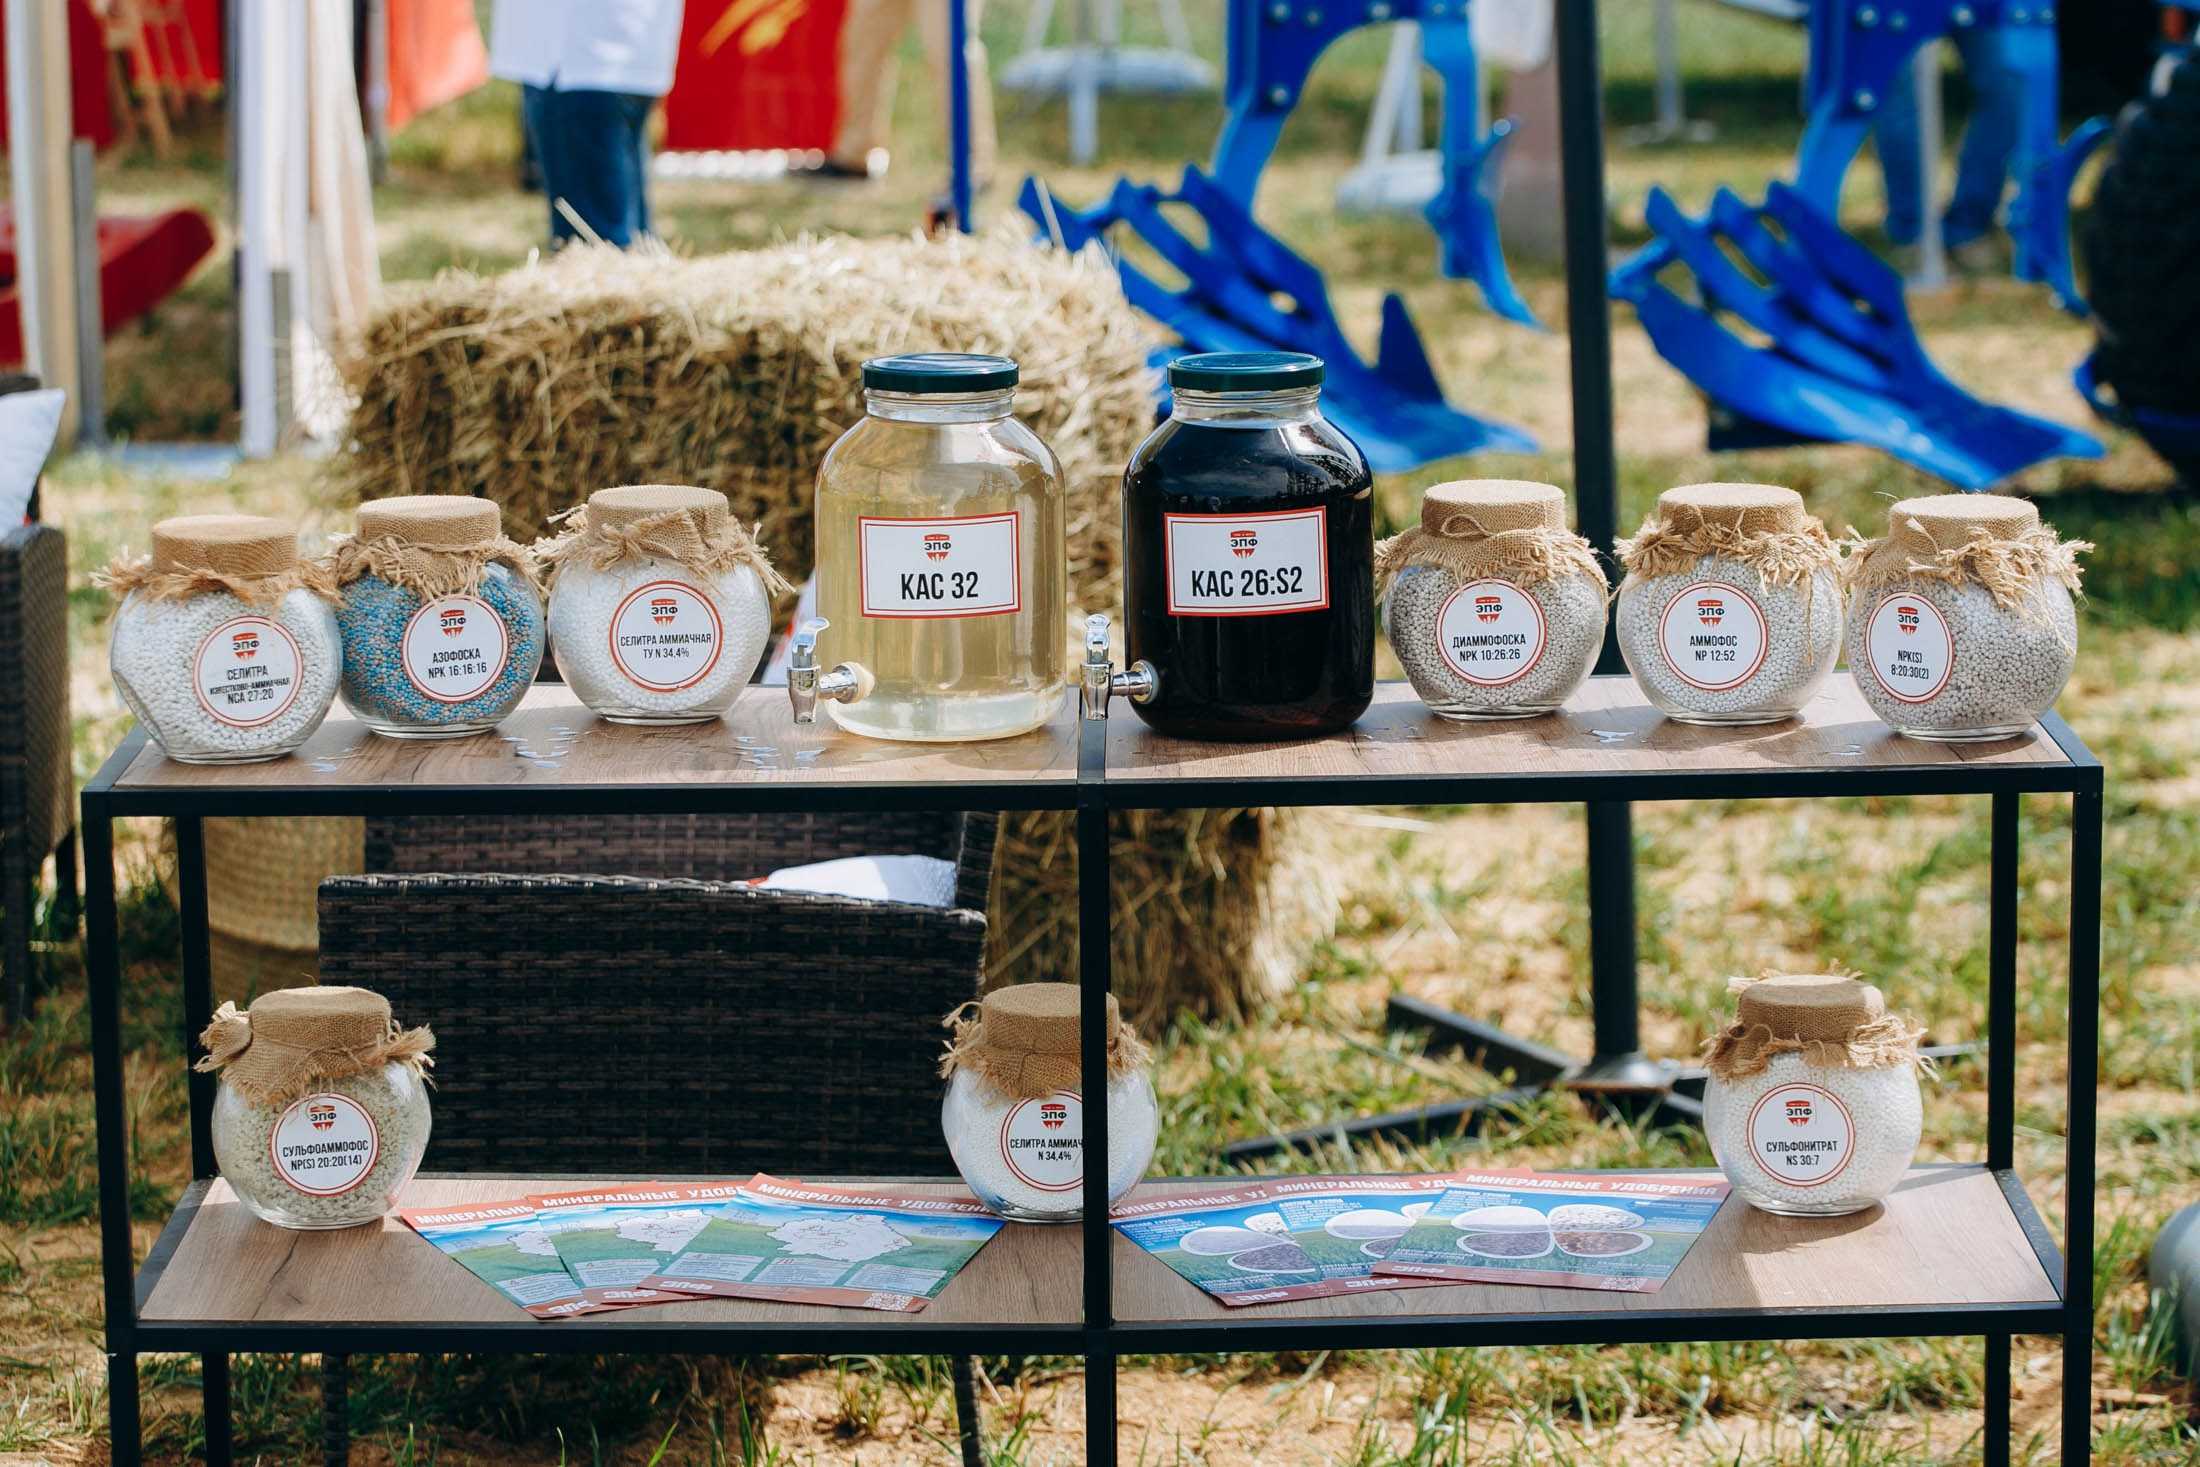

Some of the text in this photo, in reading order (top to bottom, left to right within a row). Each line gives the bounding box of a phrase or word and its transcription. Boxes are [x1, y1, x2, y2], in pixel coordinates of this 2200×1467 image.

[924, 541, 952, 551] ЭПФ
[1230, 538, 1258, 548] ЭПФ
[901, 571, 979, 600] КАС 32
[1191, 566, 1303, 597] КАС 26:S2
[651, 606, 678, 615] ЭПФ
[1475, 604, 1503, 613] ЭПФ
[1698, 607, 1725, 616] ЭПФ
[440, 617, 466, 627] ЭПФ
[1898, 614, 1920, 624] ЭПФ
[233, 640, 260, 651] ЭПФ
[620, 633, 712, 647] СЕЛИТРА АММИАЧНАЯ
[1452, 634, 1526, 649] ДИАММОФОСКА
[1689, 635, 1738, 647] АММОФОС
[433, 648, 481, 664] АЗОФОСКА
[643, 647, 690, 659] ТУ N 34,4%
[1459, 649, 1521, 662] NPK 10:26:26
[1695, 650, 1736, 661] NP 12:52
[1898, 650, 1923, 664] NPK(S)
[227, 665, 268, 681] СЕЛИТРА
[428, 662, 487, 679] NPK 16:16:16
[228, 688, 274, 704] NCA 27:20
[310, 1112, 337, 1122] ЭПФ
[1041, 1111, 1067, 1120] ЭПФ
[1785, 1108, 1813, 1116] ЭПФ
[282, 1140, 369, 1158] СУЛЬФОАММОФОС
[1010, 1138, 1046, 1149] СЕЛИТРА
[1766, 1140, 1838, 1152] СУЛЬФОНИТРАТ
[291, 1154, 362, 1171] NP(S) 20:20(14)
[1038, 1151, 1072, 1162] N 34,4%
[1786, 1155, 1820, 1166] NS 30:7
[1276, 1180, 1413, 1193] МИНЕРАЛЬНЫЕ
[1466, 1174, 1717, 1196] МИНЕРАЛЬНЫЕ УДОБРЕНИЯ
[541, 1190, 679, 1207] МИНЕРАЛЬНЫЕ
[757, 1183, 892, 1205] МИНЕРАЛЬНЫЕ
[1108, 1194, 1241, 1216] МИНЕРАЛЬНЫЕ
